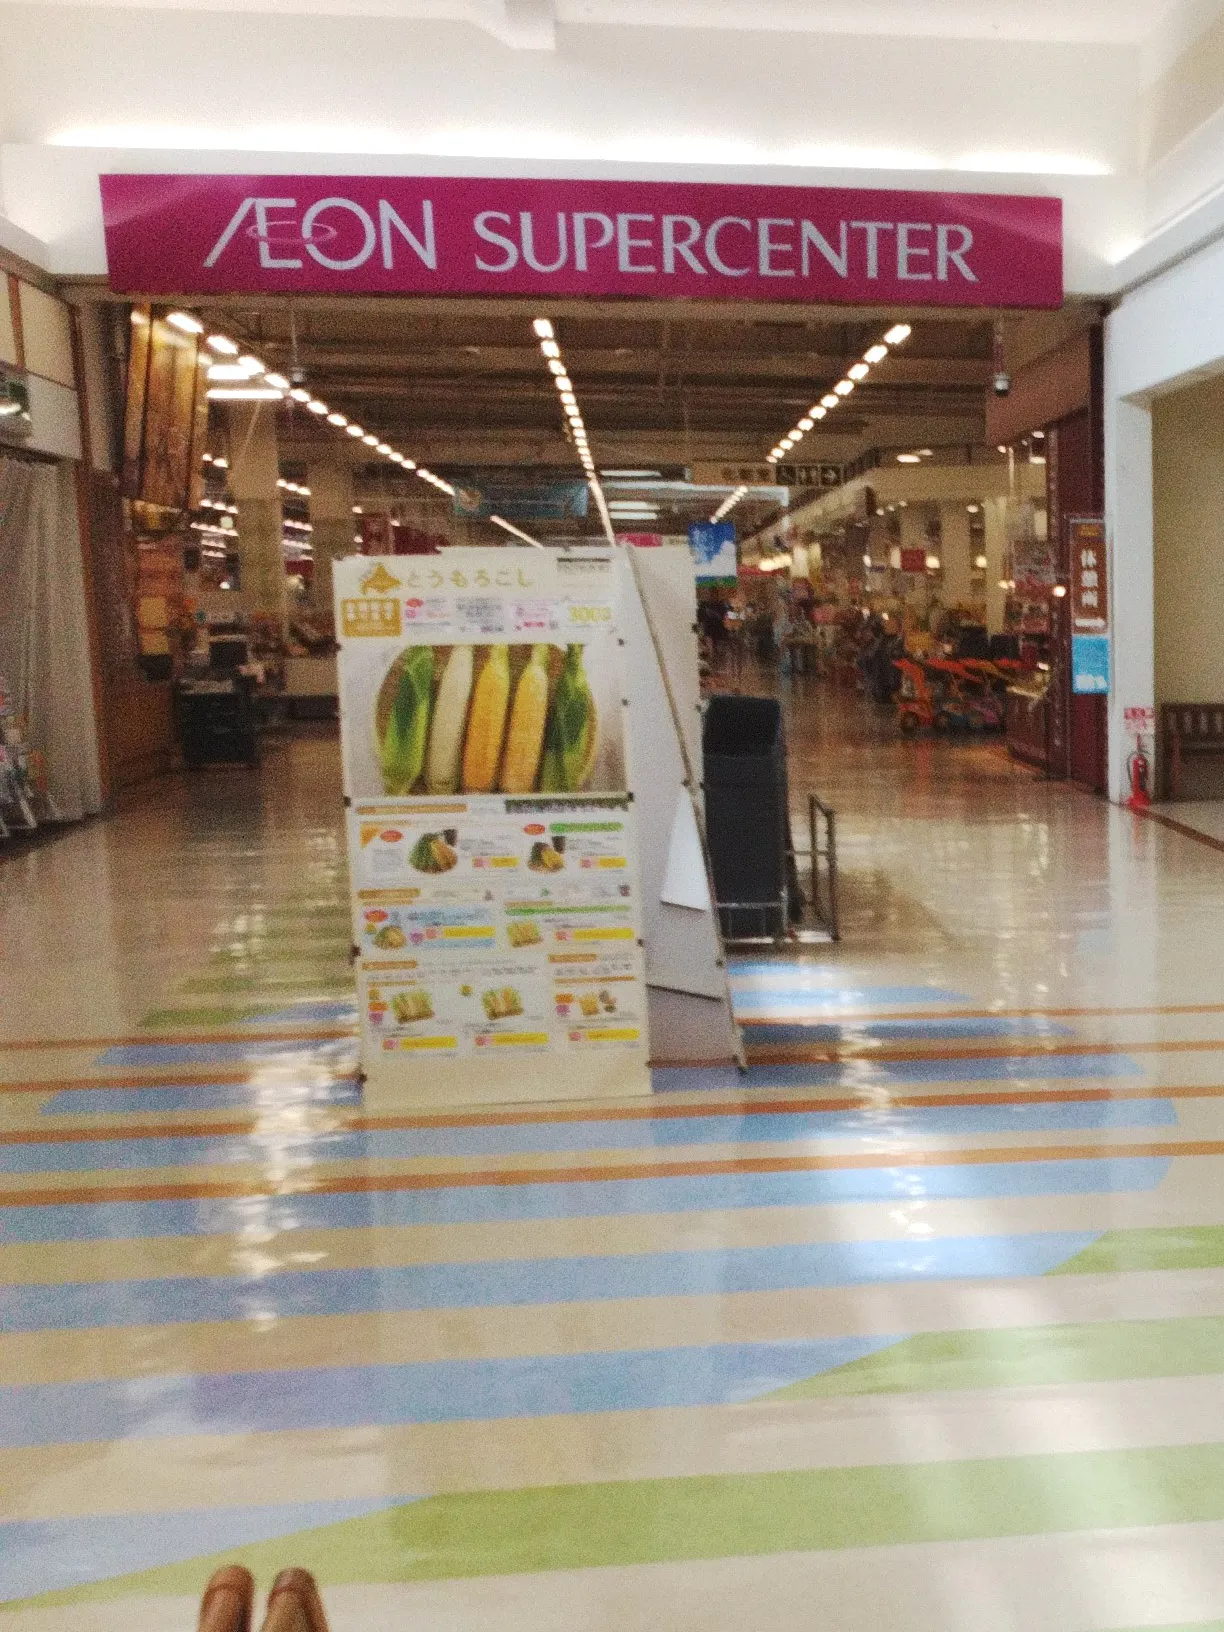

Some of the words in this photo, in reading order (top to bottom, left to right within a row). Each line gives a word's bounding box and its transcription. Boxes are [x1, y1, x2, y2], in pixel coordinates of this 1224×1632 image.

[473, 210, 979, 282] SUPERCENTER
[407, 569, 534, 589] とうもろこし
